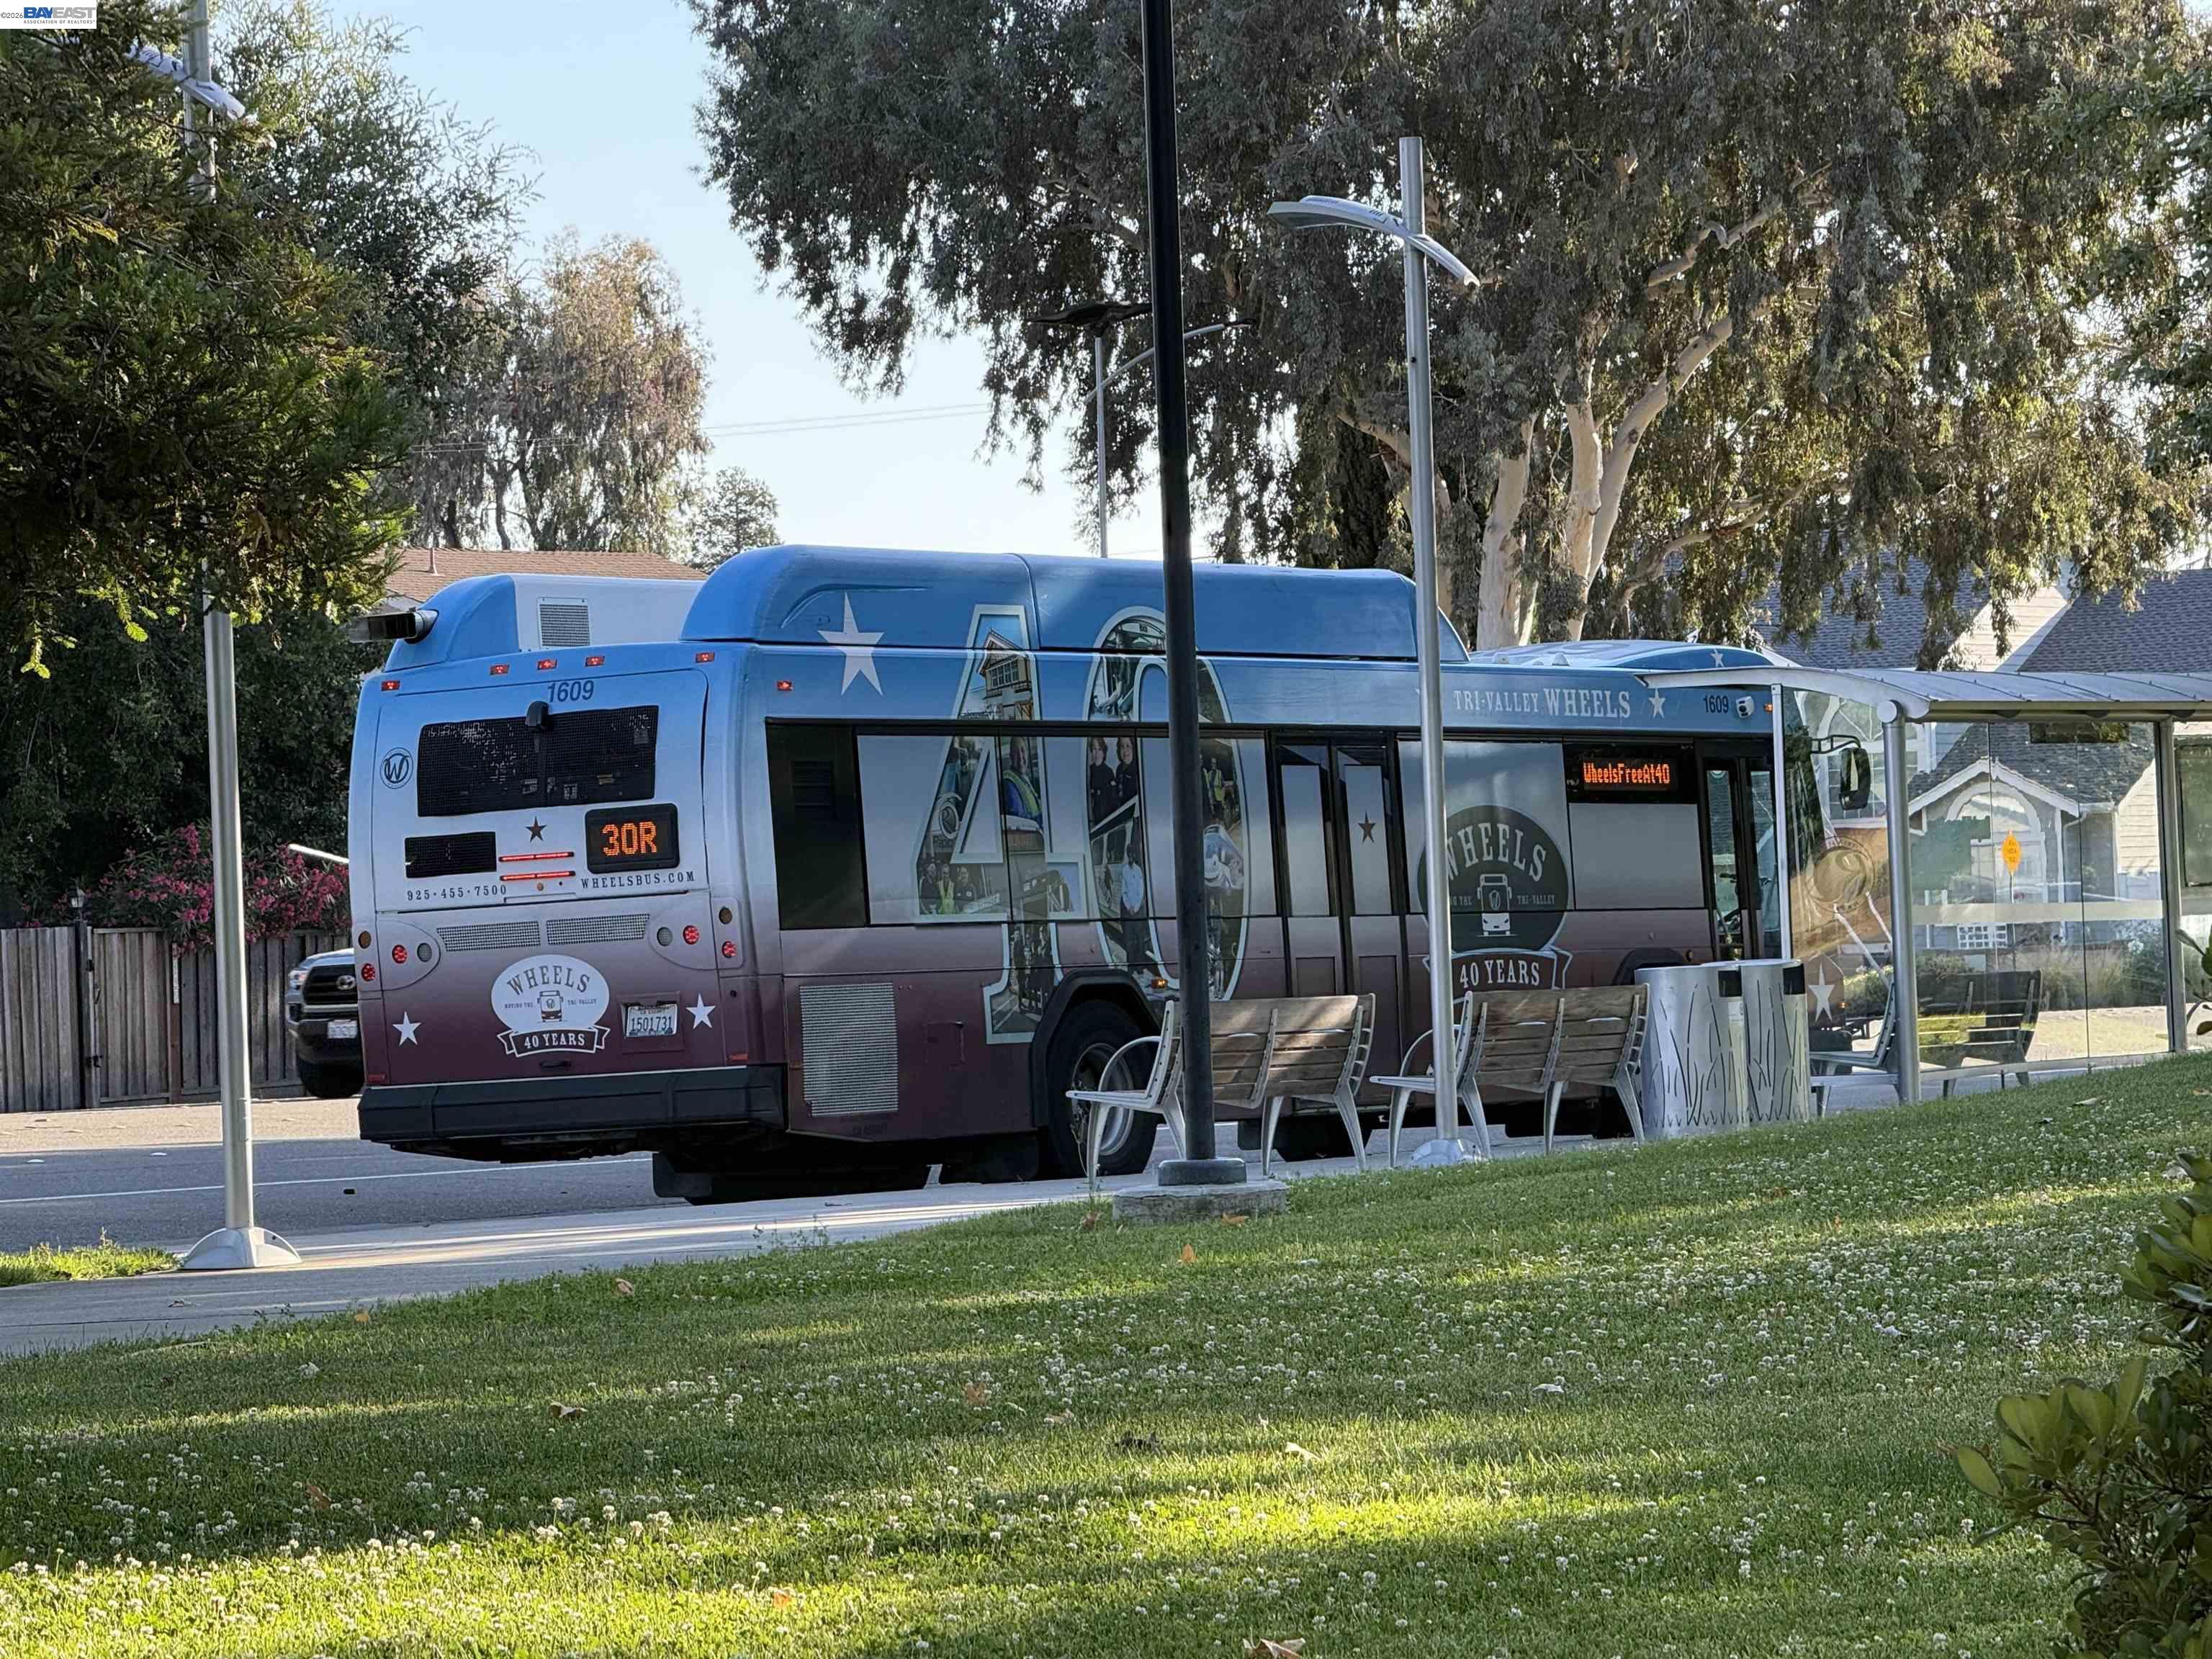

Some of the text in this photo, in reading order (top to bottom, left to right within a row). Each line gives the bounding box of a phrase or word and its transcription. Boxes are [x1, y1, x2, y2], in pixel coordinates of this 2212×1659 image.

[547, 680, 594, 703] 1609
[1454, 688, 1631, 719] TRI-VALLEY WHEELS
[1704, 696, 1729, 714] 1609
[602, 820, 657, 857] 30R
[580, 871, 695, 889] WHEELSBUS.COM
[506, 965, 590, 996] WHEELS
[1459, 958, 1540, 989] 40 YEARS
[631, 1016, 673, 1032] 1501731
[524, 1033, 585, 1049] 40 YEARS
